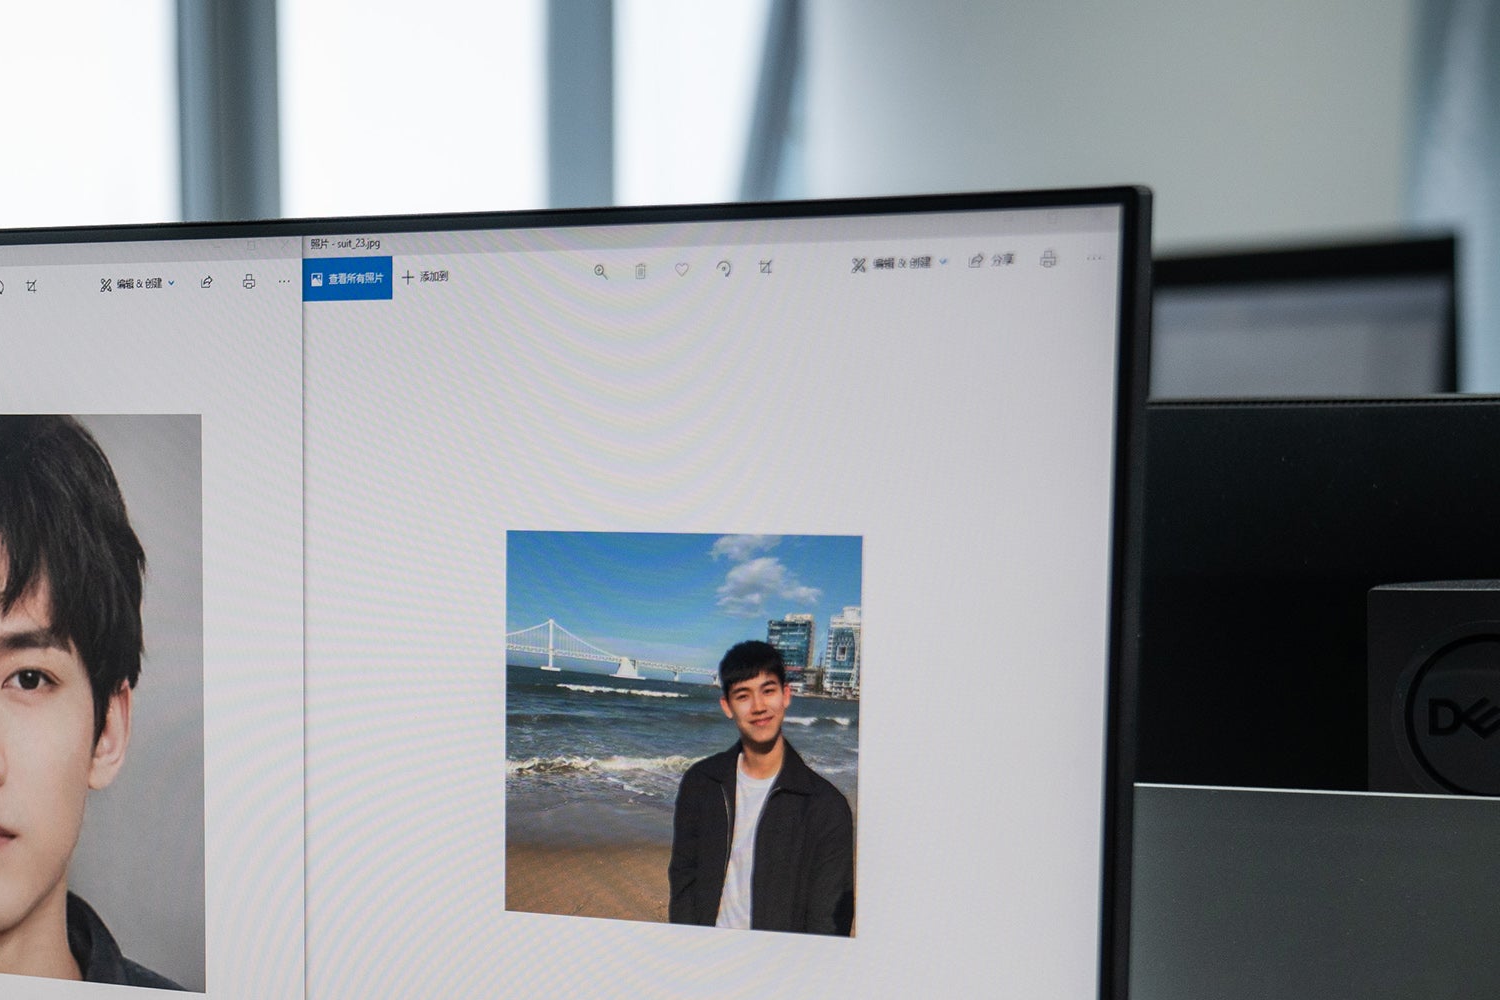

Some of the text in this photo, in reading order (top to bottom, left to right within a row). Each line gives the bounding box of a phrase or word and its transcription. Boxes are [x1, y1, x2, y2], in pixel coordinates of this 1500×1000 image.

[311, 238, 381, 250] 照片 suit_23.jpg
[328, 271, 384, 286] 查看所有照片
[420, 270, 449, 283] 添加到
[136, 279, 144, 288] &
[145, 277, 163, 289] 创建
